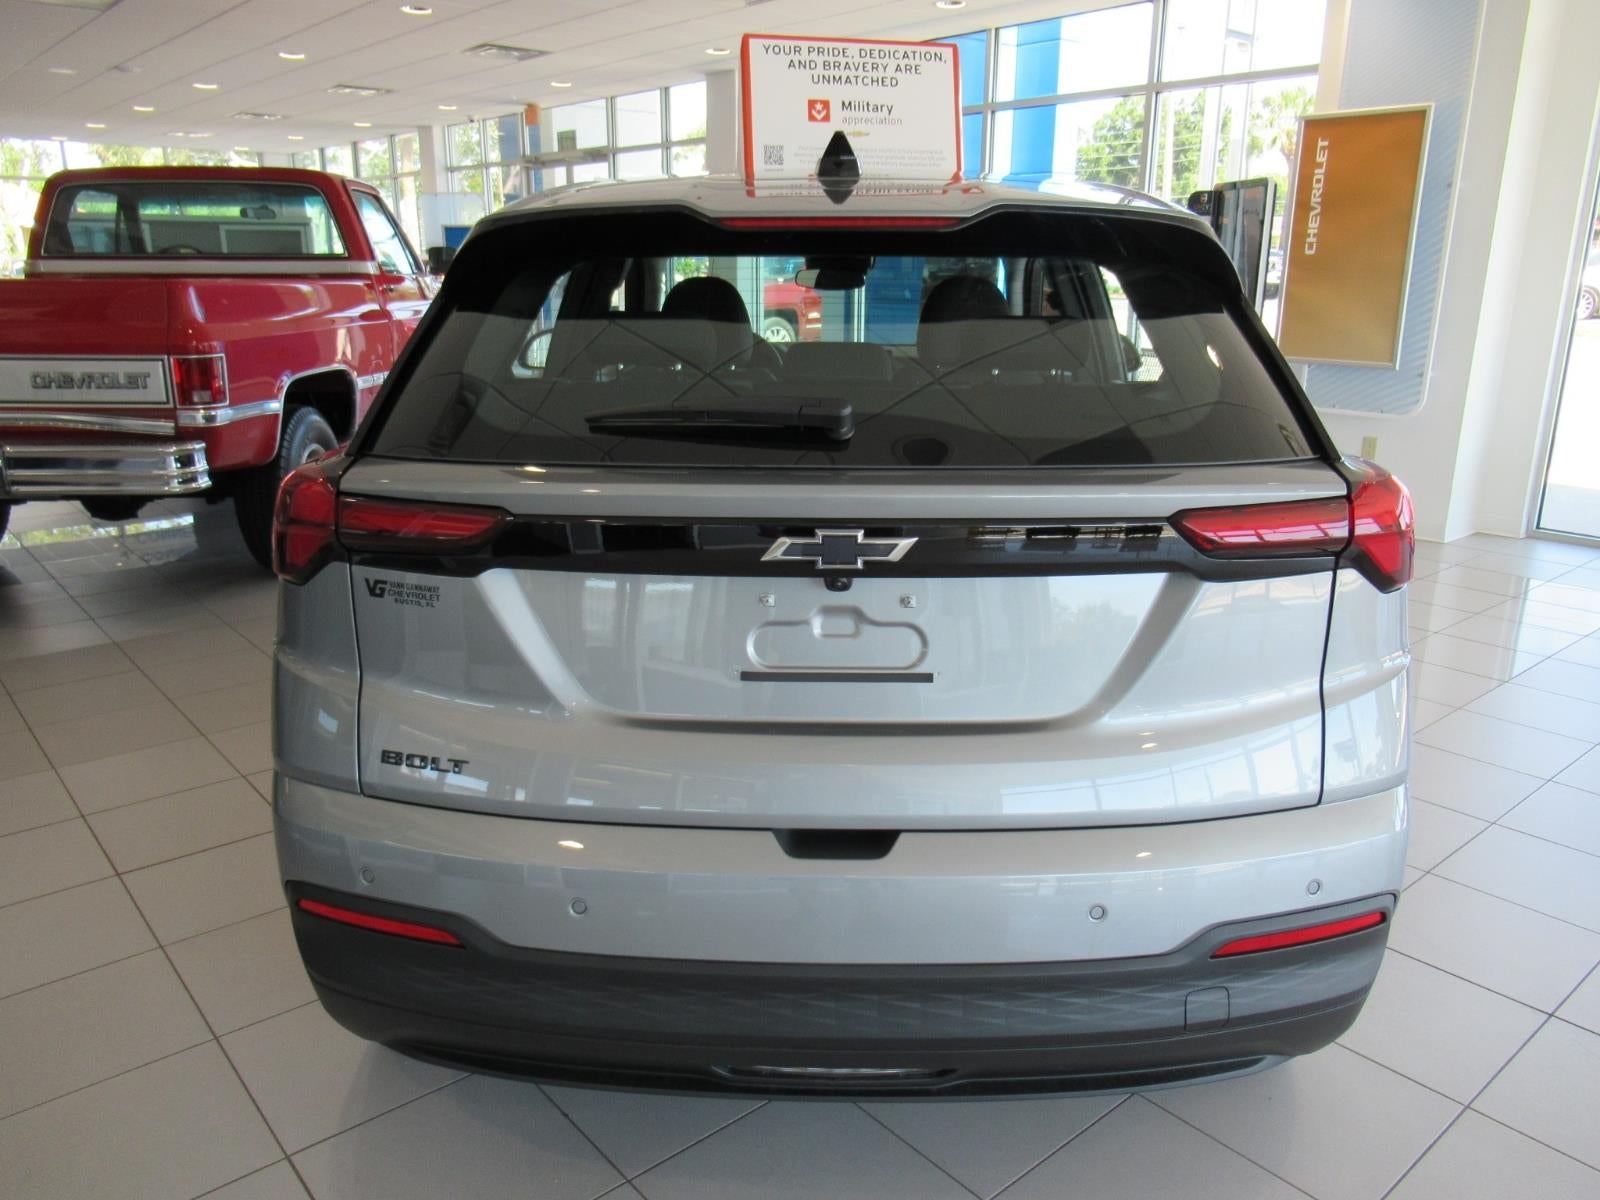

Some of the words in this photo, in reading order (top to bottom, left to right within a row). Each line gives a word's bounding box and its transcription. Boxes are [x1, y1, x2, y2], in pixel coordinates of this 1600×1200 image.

[762, 44, 802, 55] YOUR
[807, 46, 855, 59] PRIDE,
[859, 48, 948, 64] DEDICATION,
[787, 59, 817, 71] AND
[822, 60, 889, 74] BRAVERY
[894, 63, 922, 75] ARE
[811, 74, 899, 88] UNMATCHED
[841, 100, 894, 116] Military
[841, 115, 903, 126] appreciation
[1304, 137, 1329, 256] CHEVROLET
[31, 371, 150, 390] CHEVROLET
[387, 588, 440, 602] CHEVROLET
[381, 749, 469, 775] BOLT
